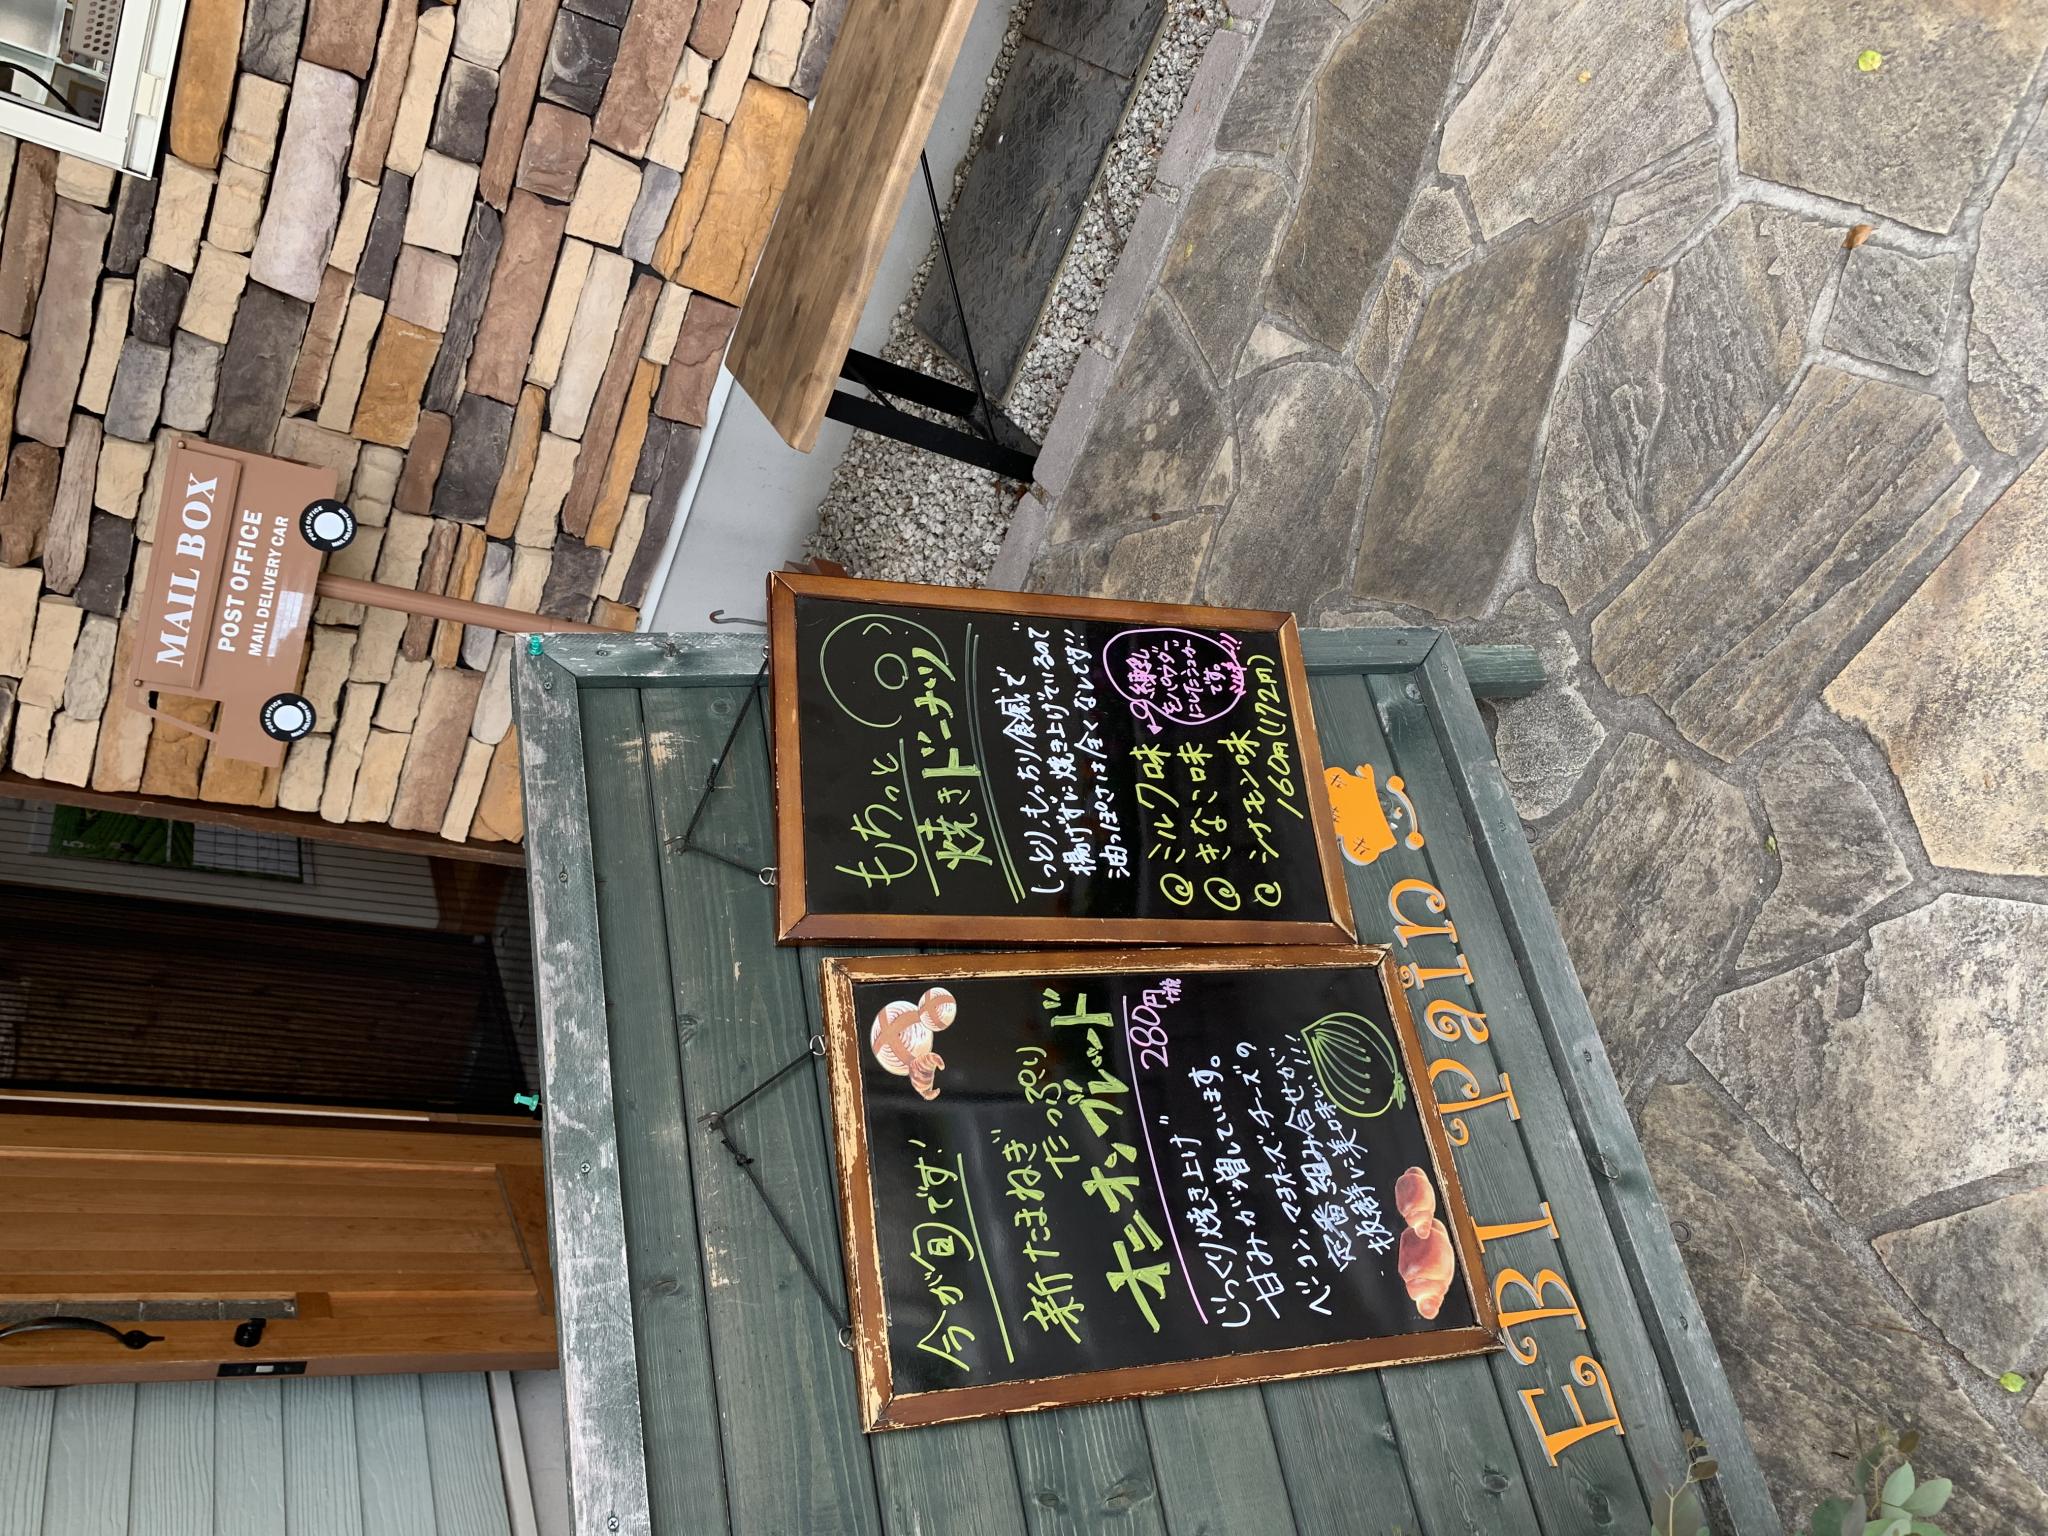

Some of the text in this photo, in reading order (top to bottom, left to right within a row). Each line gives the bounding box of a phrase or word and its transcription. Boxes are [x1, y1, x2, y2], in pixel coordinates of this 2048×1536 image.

[156, 472, 218, 667] MAIL BOX
[217, 510, 262, 652] POST OFFICE
[248, 516, 289, 657] MAIL DELIVERY CAR
[835, 753, 917, 888] もちっと
[912, 647, 992, 870] 焼きドーナツ
[1042, 988, 1171, 1334] オニオンブレッド
[1384, 878, 1625, 1467] EBI Pain
